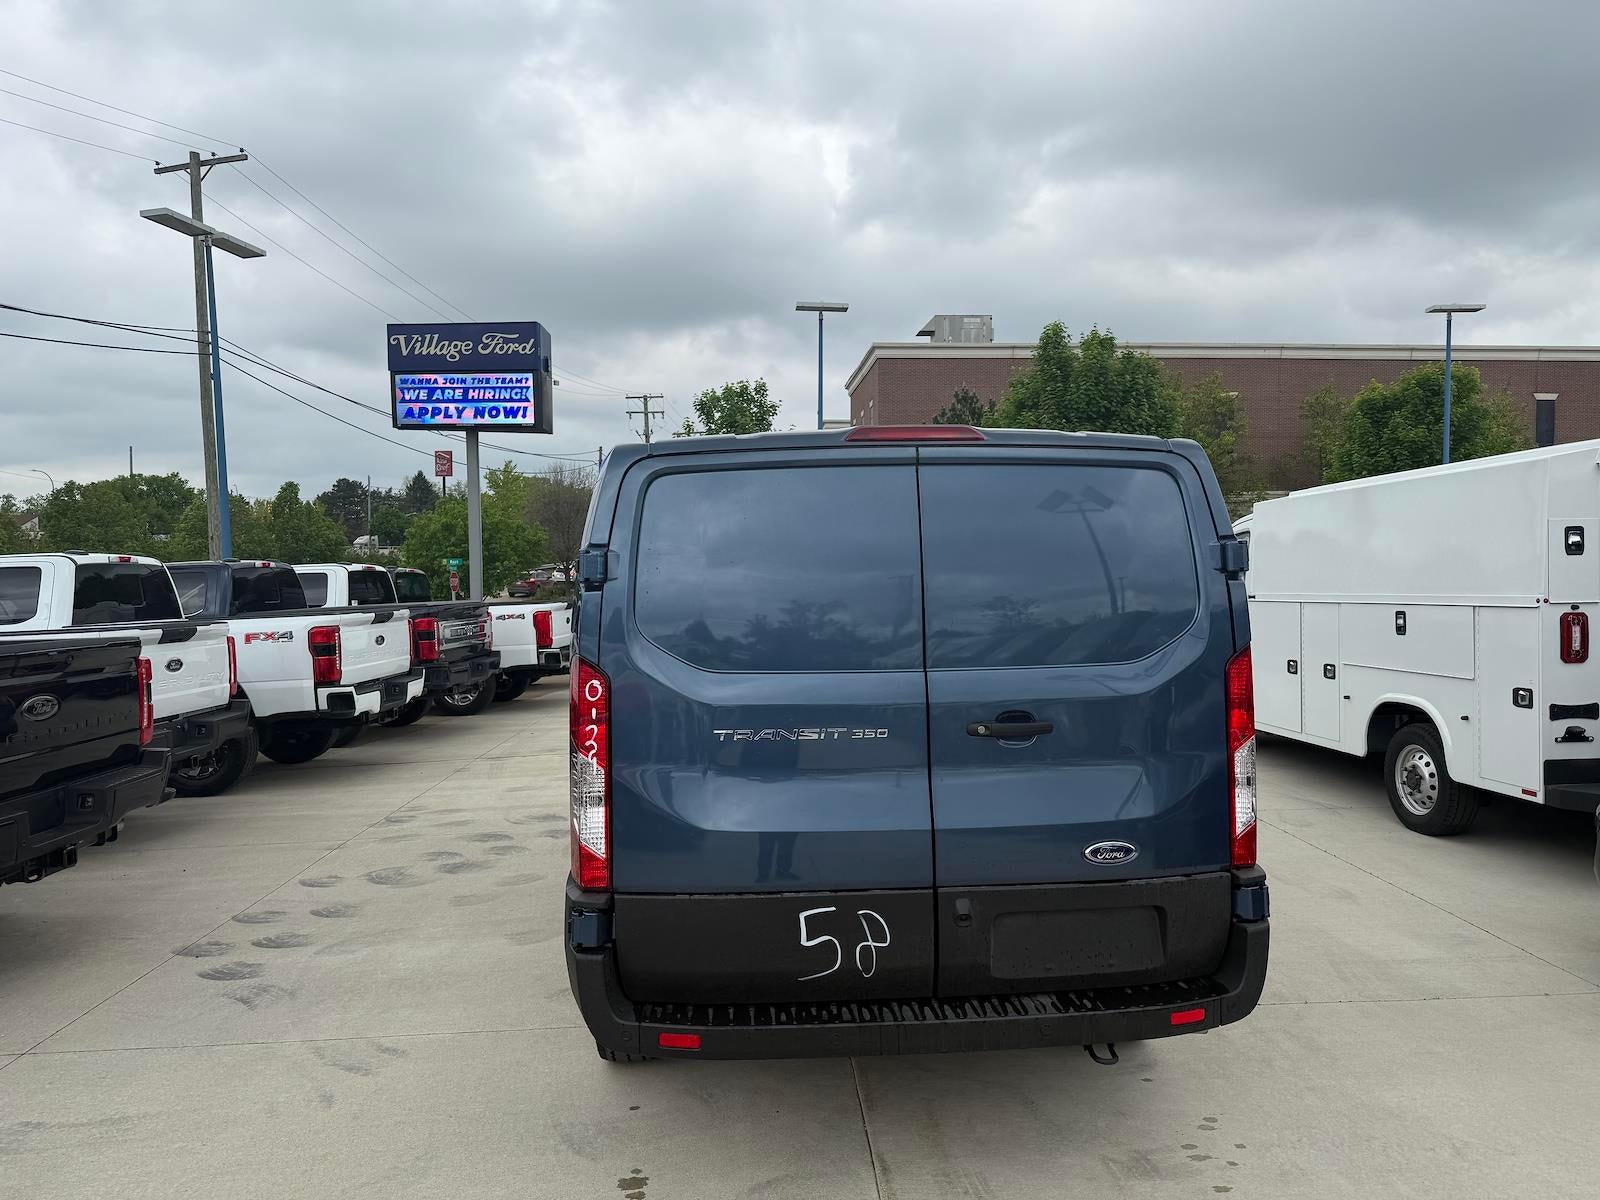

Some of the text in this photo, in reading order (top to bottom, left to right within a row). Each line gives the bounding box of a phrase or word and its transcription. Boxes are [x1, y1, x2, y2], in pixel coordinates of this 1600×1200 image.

[390, 332, 535, 361] Village Ford
[471, 377, 493, 385] THE
[495, 377, 529, 385] TEAM?
[403, 388, 527, 400] WE ARE HIRING!
[403, 406, 528, 419] APPLY NOW!
[243, 630, 294, 645] FX4
[712, 727, 889, 742] TRANSIT 350
[797, 906, 891, 981] 58
